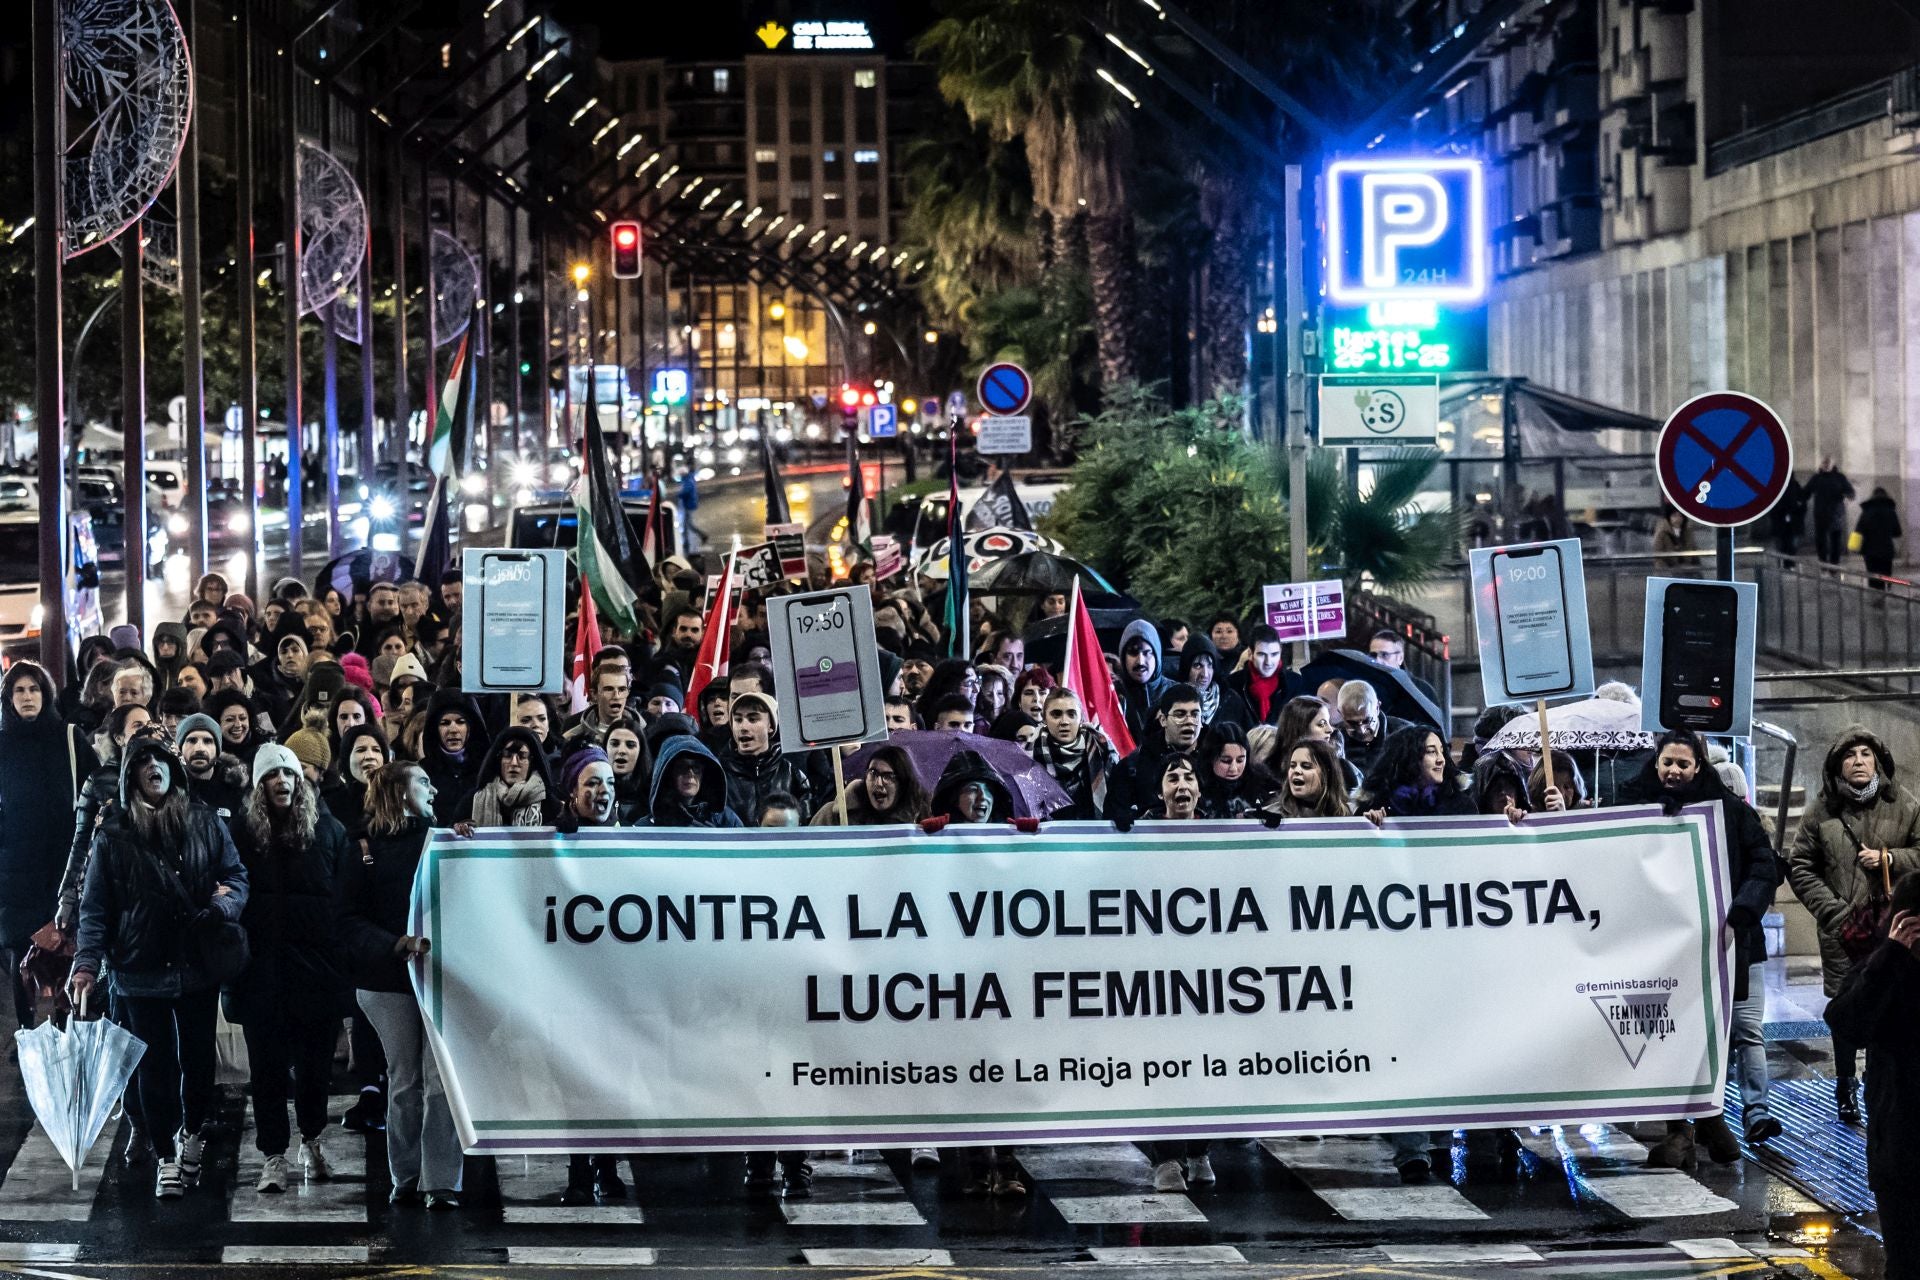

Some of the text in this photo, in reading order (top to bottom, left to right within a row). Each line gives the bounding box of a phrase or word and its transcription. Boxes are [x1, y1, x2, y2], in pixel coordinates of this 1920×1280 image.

[1363, 173, 1448, 288] P
[1403, 268, 1446, 285] 24H
[1509, 566, 1546, 582] 19:00
[543, 878, 1602, 945] ¡CONTRA LA VIOLENCIA MACHISTA,
[805, 964, 1354, 1024] LUCHA FEMINISTA!
[1575, 976, 1679, 993] @feministasrioja
[1610, 1003, 1669, 1020] FEMINISTAS
[1619, 1019, 1676, 1038] DE LA RIOJA
[792, 1048, 1371, 1089] Feministas de La Rioja por la abolición
